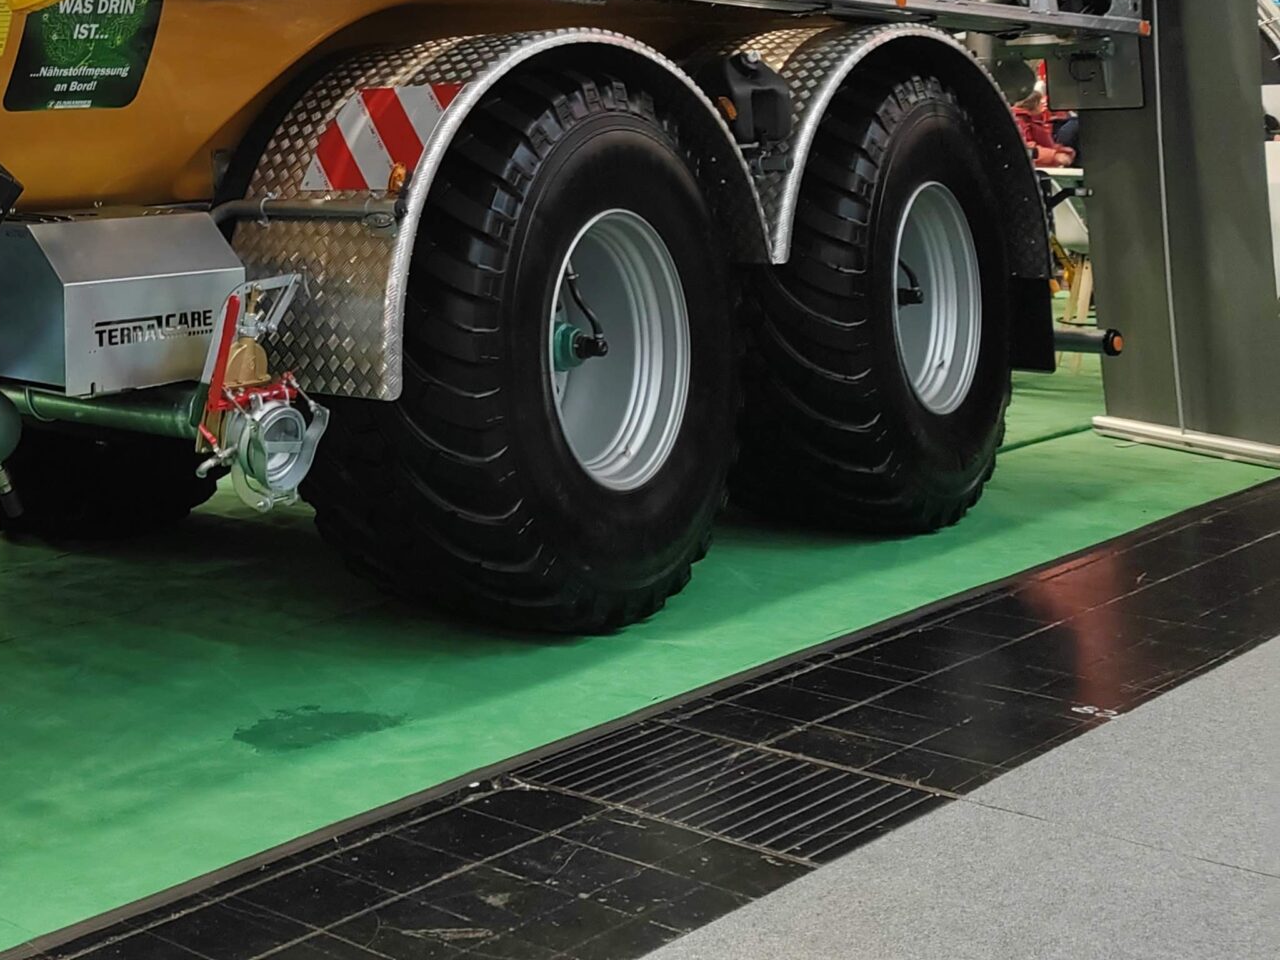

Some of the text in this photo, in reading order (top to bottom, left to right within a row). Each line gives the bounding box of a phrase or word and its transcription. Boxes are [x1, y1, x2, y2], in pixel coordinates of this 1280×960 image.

[73, 23, 109, 40] IST...
[53, 80, 97, 92] an Bord!
